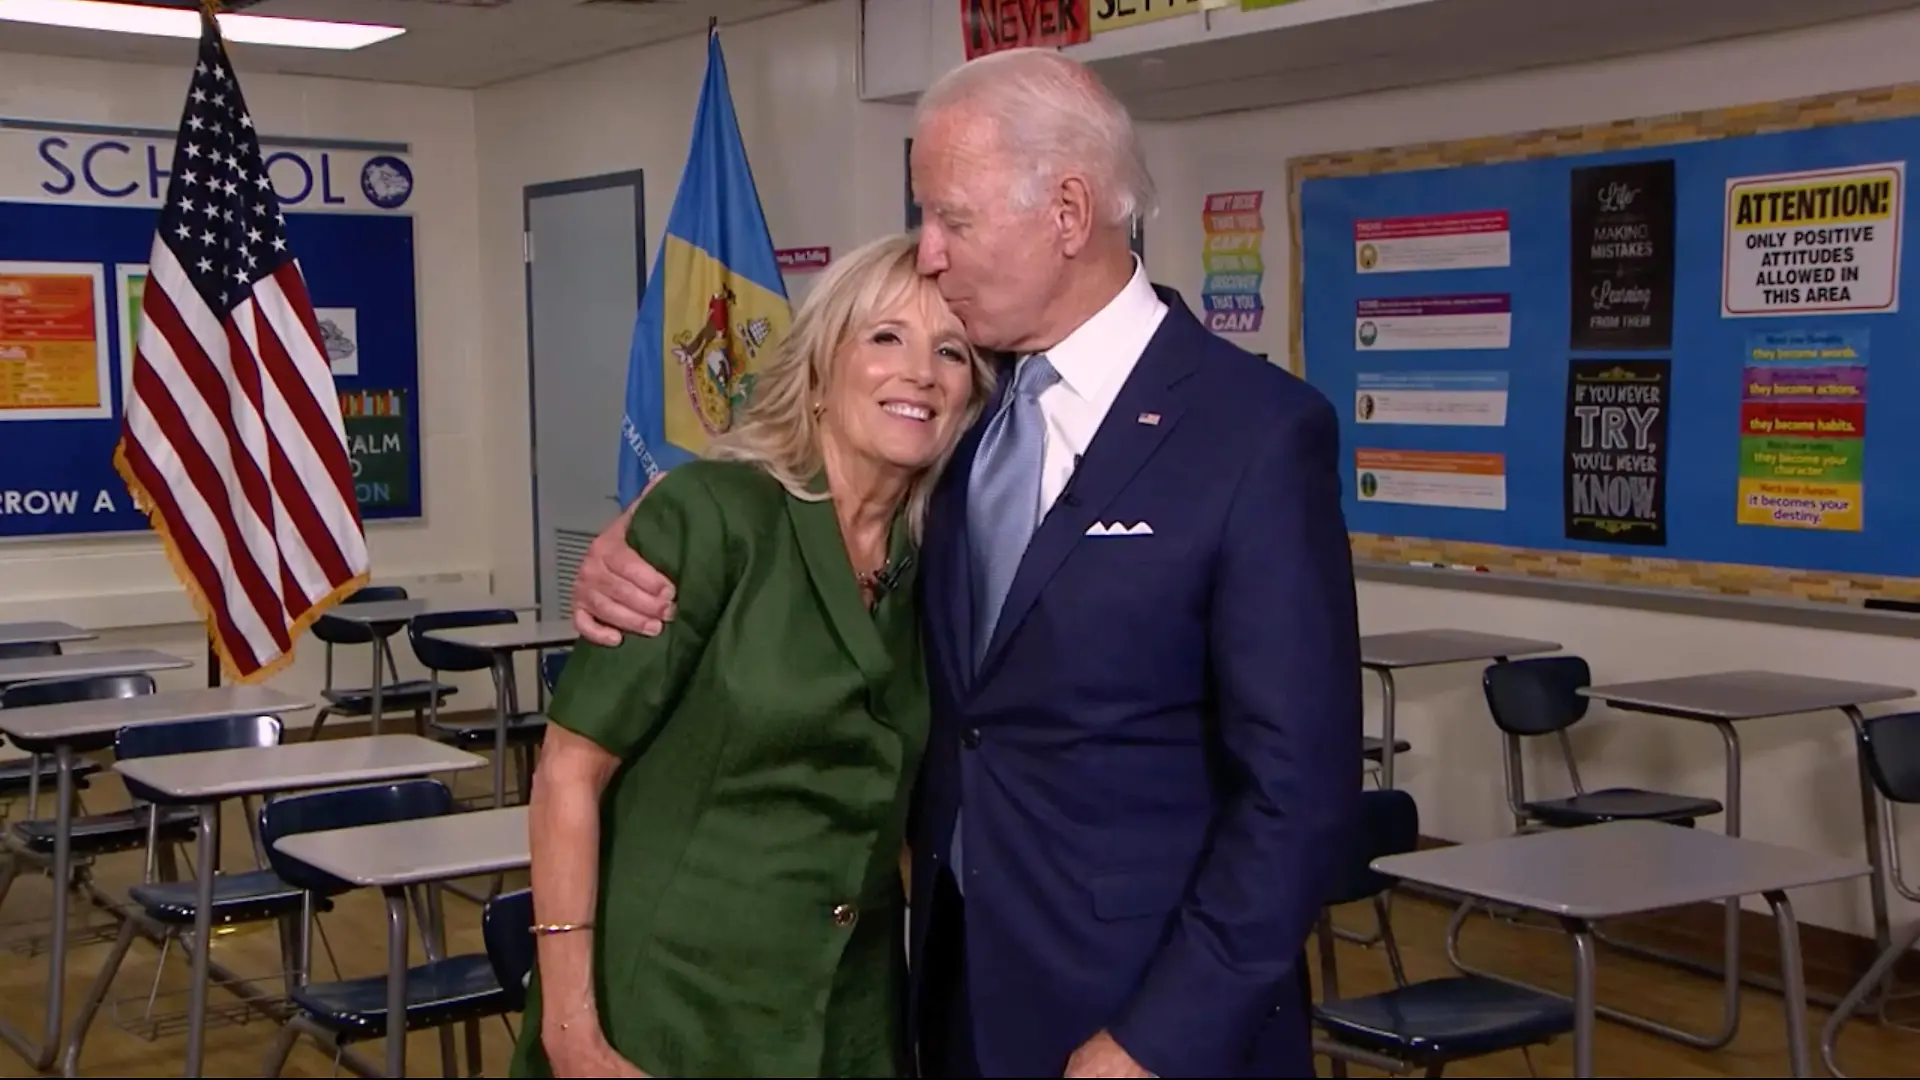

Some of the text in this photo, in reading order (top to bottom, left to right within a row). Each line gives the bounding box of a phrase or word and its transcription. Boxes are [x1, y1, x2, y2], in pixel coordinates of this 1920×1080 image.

[970, 0, 1080, 49] NEVER
[37, 137, 345, 205] SCHOL
[1597, 182, 1642, 211] Life
[1736, 180, 1889, 225] ATTENTION!
[1593, 224, 1648, 241] MAKING
[1746, 226, 1874, 249] ONLY POSITIVE
[1590, 242, 1653, 259] MISTAKES
[1761, 247, 1854, 267] ATTITUDES
[1756, 267, 1859, 286] ALLOWED IN
[1591, 280, 1651, 310] Learning
[1764, 287, 1851, 304] THIS AREA
[1212, 313, 1255, 331] CAN
[1590, 315, 1651, 328] FROM THEM
[1575, 384, 1660, 403] IF YOU NEVER
[1749, 382, 1772, 397] they
[1574, 406, 1660, 453] TRY,
[1750, 417, 1773, 432] they
[347, 432, 401, 454] ALM
[1572, 452, 1657, 473] YOU'LL NEVER
[0, 490, 79, 515] ROW
[93, 489, 116, 513] A
[355, 482, 390, 502] ON
[1572, 474, 1656, 519] KNOW.
[1748, 494, 1848, 512] it becomes your
[1774, 509, 1821, 524] destiny.
